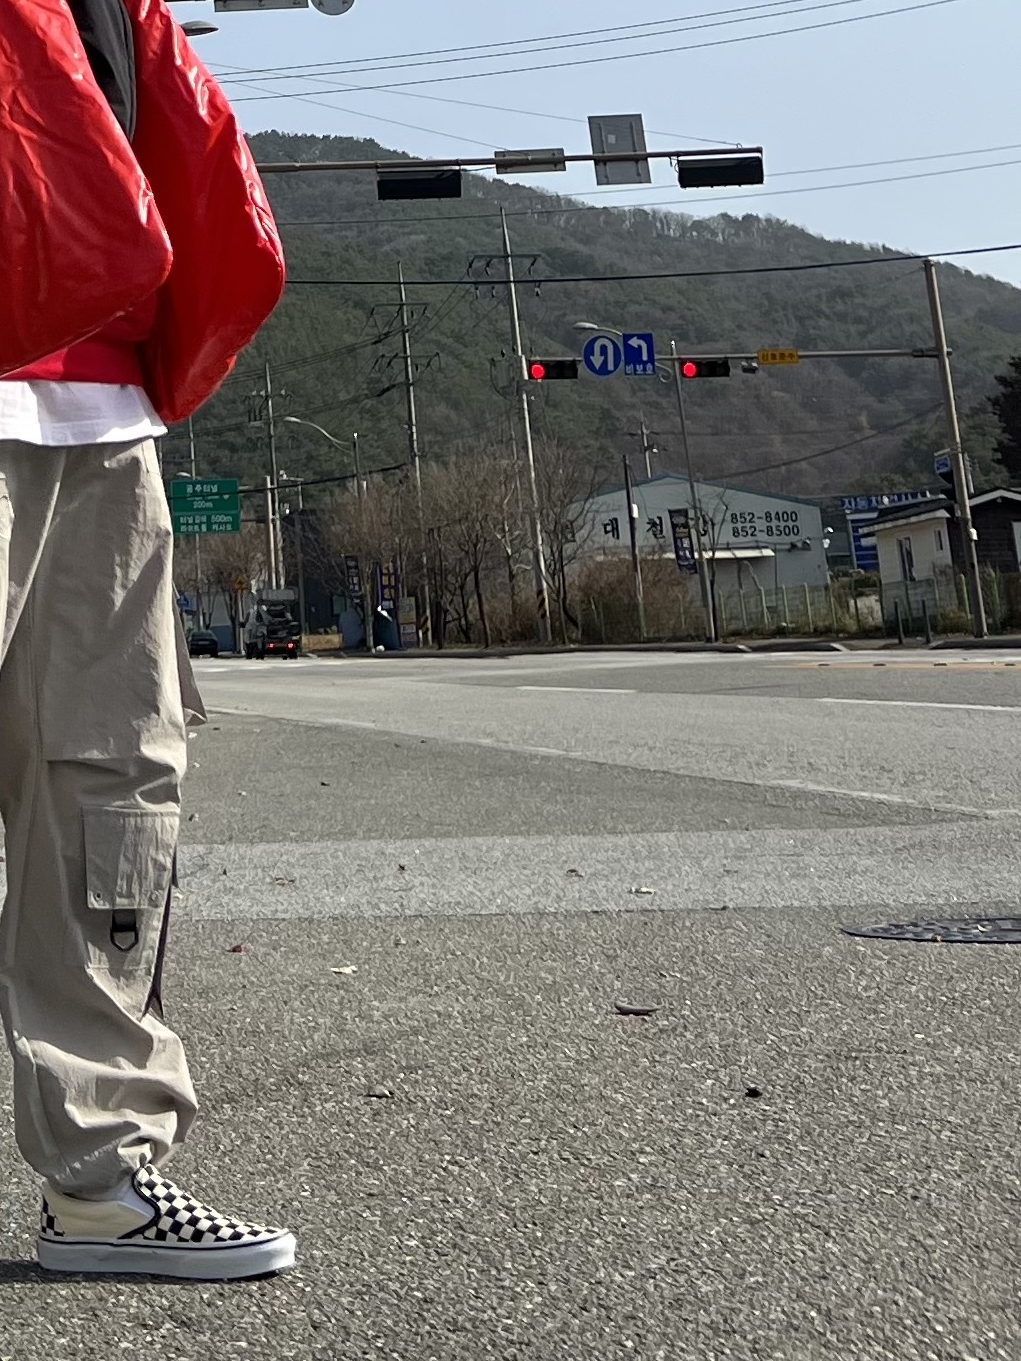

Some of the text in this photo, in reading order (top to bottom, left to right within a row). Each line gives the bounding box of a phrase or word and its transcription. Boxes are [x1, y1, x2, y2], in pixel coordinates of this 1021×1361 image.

[625, 362, 655, 375] 비보호
[730, 510, 799, 525] 852-8400
[731, 524, 801, 538] 852-8500
